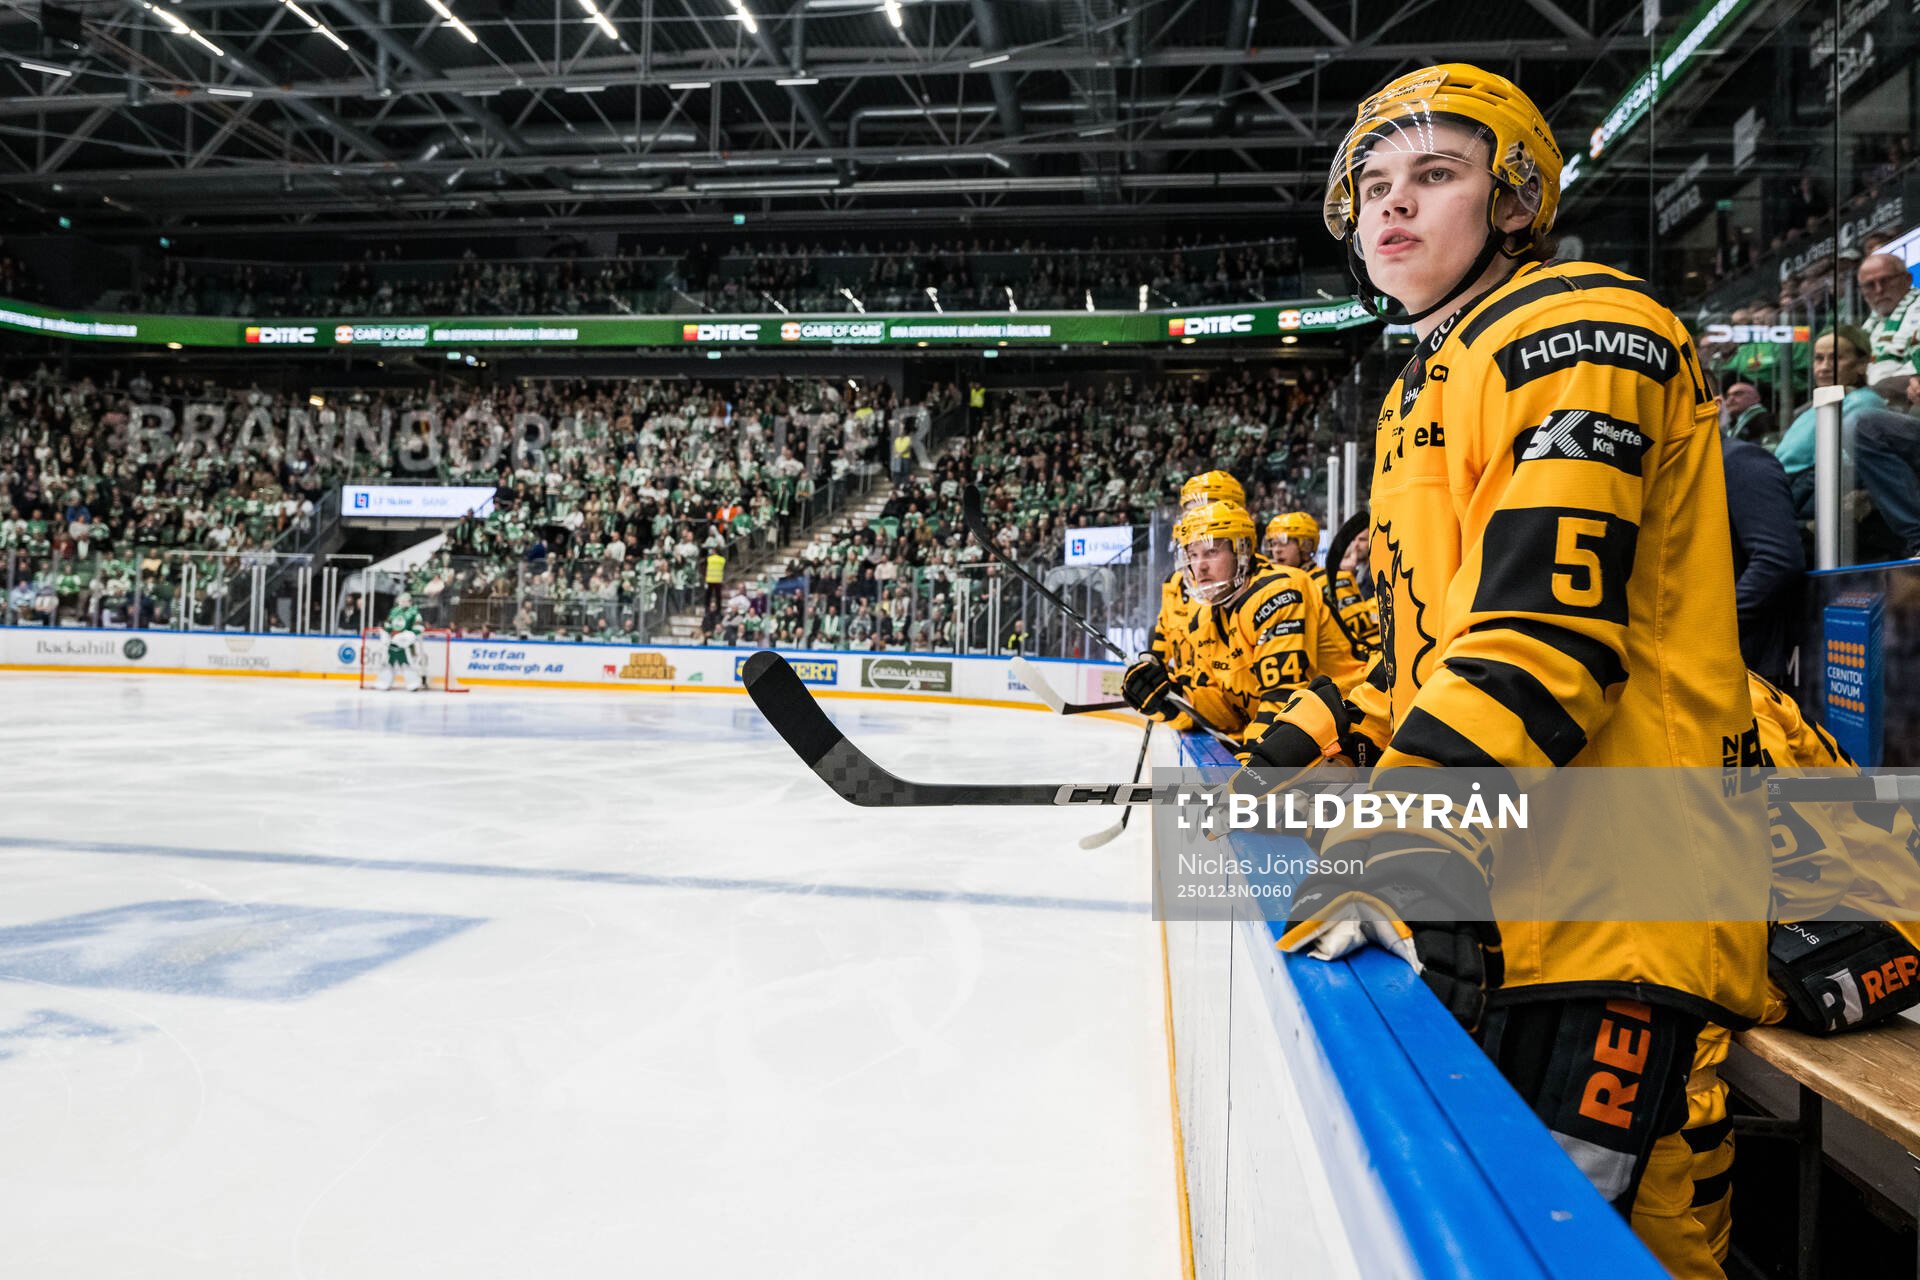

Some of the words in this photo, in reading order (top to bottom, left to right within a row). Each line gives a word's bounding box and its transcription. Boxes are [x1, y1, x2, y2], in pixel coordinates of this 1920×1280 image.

[1534, 126, 1560, 159] CCM
[698, 324, 761, 341] DITEC
[802, 324, 833, 338] CARE
[1184, 313, 1255, 335] DITEC
[1431, 310, 1461, 351] CC
[259, 327, 318, 343] DITEC
[1520, 330, 1668, 370] HOLMEN
[1552, 517, 1607, 608] 5
[1255, 592, 1296, 622] HOLMEN
[1345, 611, 1373, 635] 71
[37, 640, 115, 655] Backahill
[471, 648, 525, 660] Stefan
[467, 662, 540, 675] Nordbergh
[545, 663, 564, 673] AB
[873, 667, 906, 678] GRÖNA
[907, 668, 945, 679] GÅRDEN
[1260, 652, 1302, 688] 64
[1827, 666, 1863, 686] CERNITOL
[1830, 681, 1860, 699] NOVUM
[1861, 955, 1920, 1004] REP
